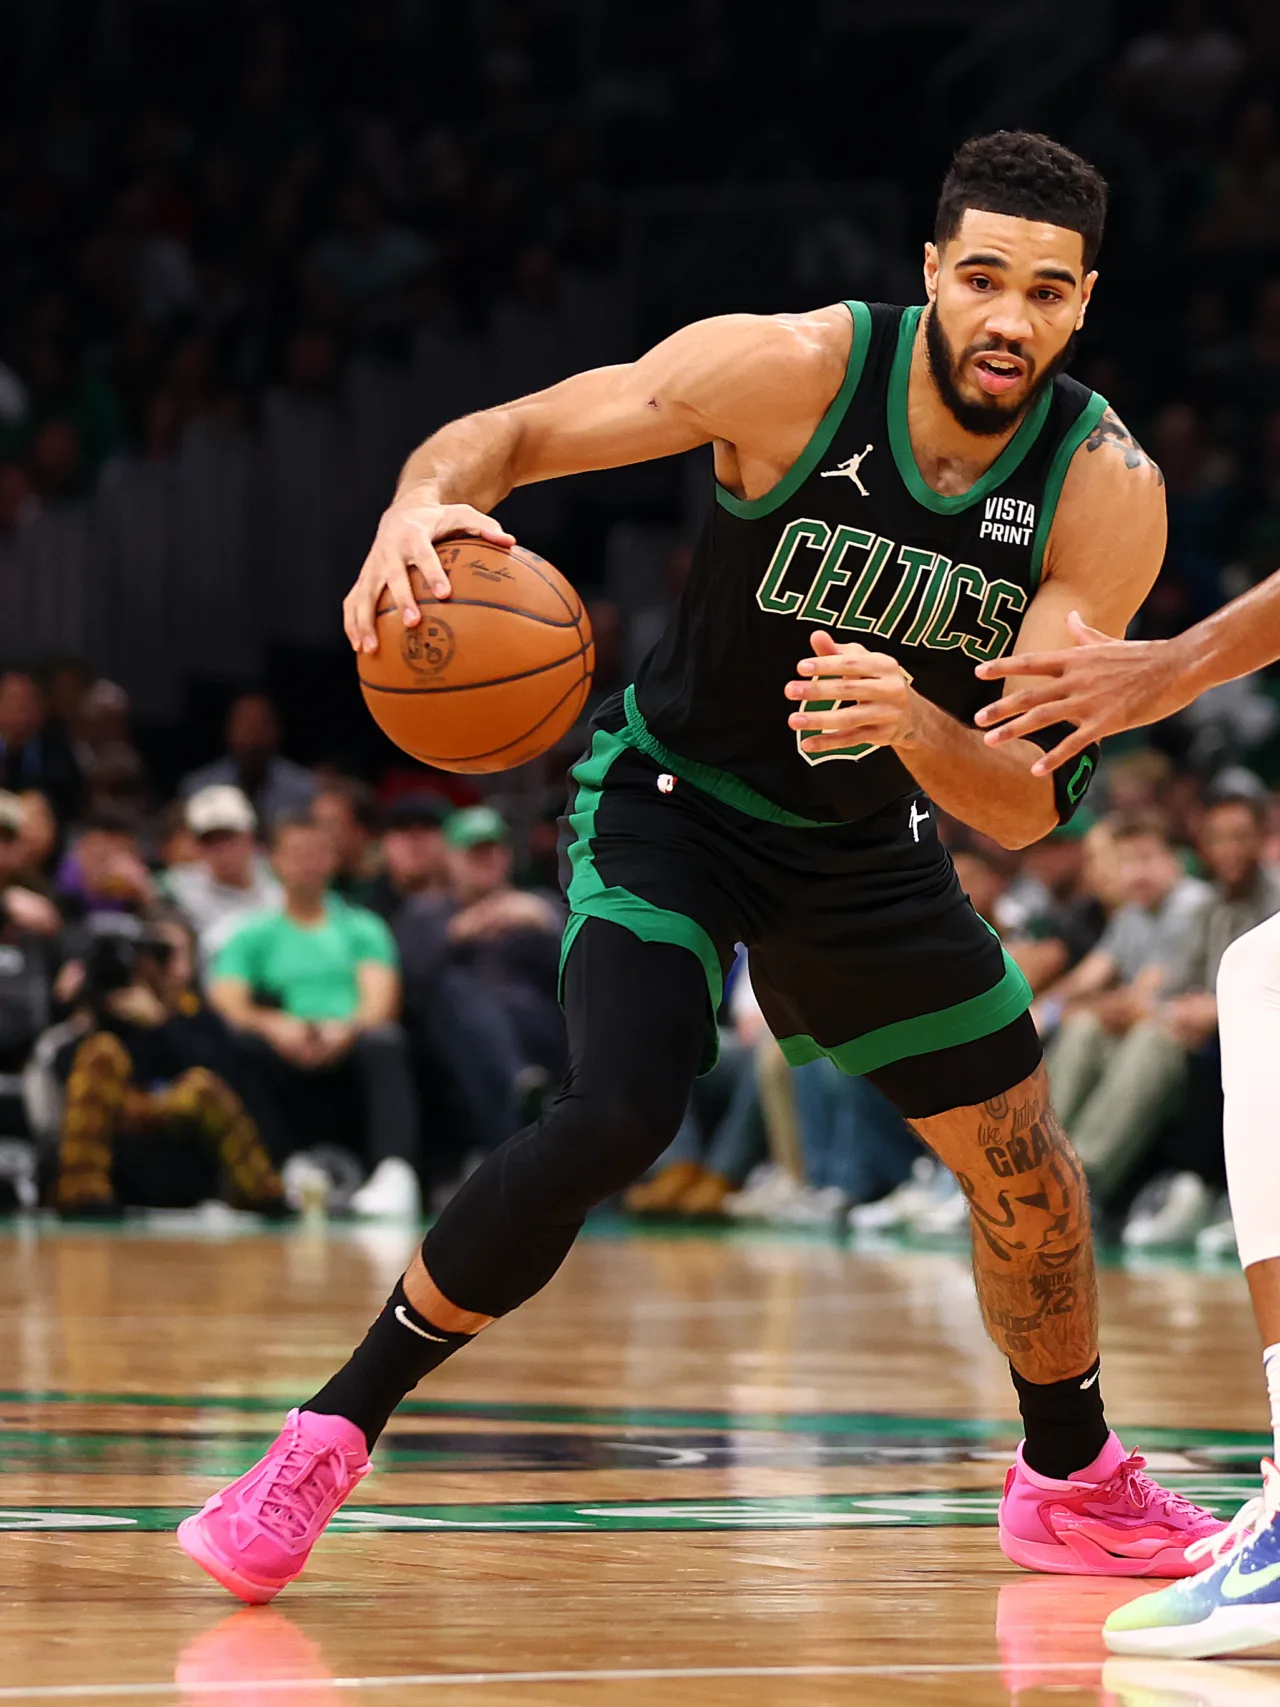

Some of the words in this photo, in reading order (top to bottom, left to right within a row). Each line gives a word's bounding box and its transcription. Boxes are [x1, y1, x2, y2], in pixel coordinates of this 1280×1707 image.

[985, 497, 1035, 528] VISTA
[979, 521, 1033, 546] PRINT
[755, 517, 1028, 664] CELTICS
